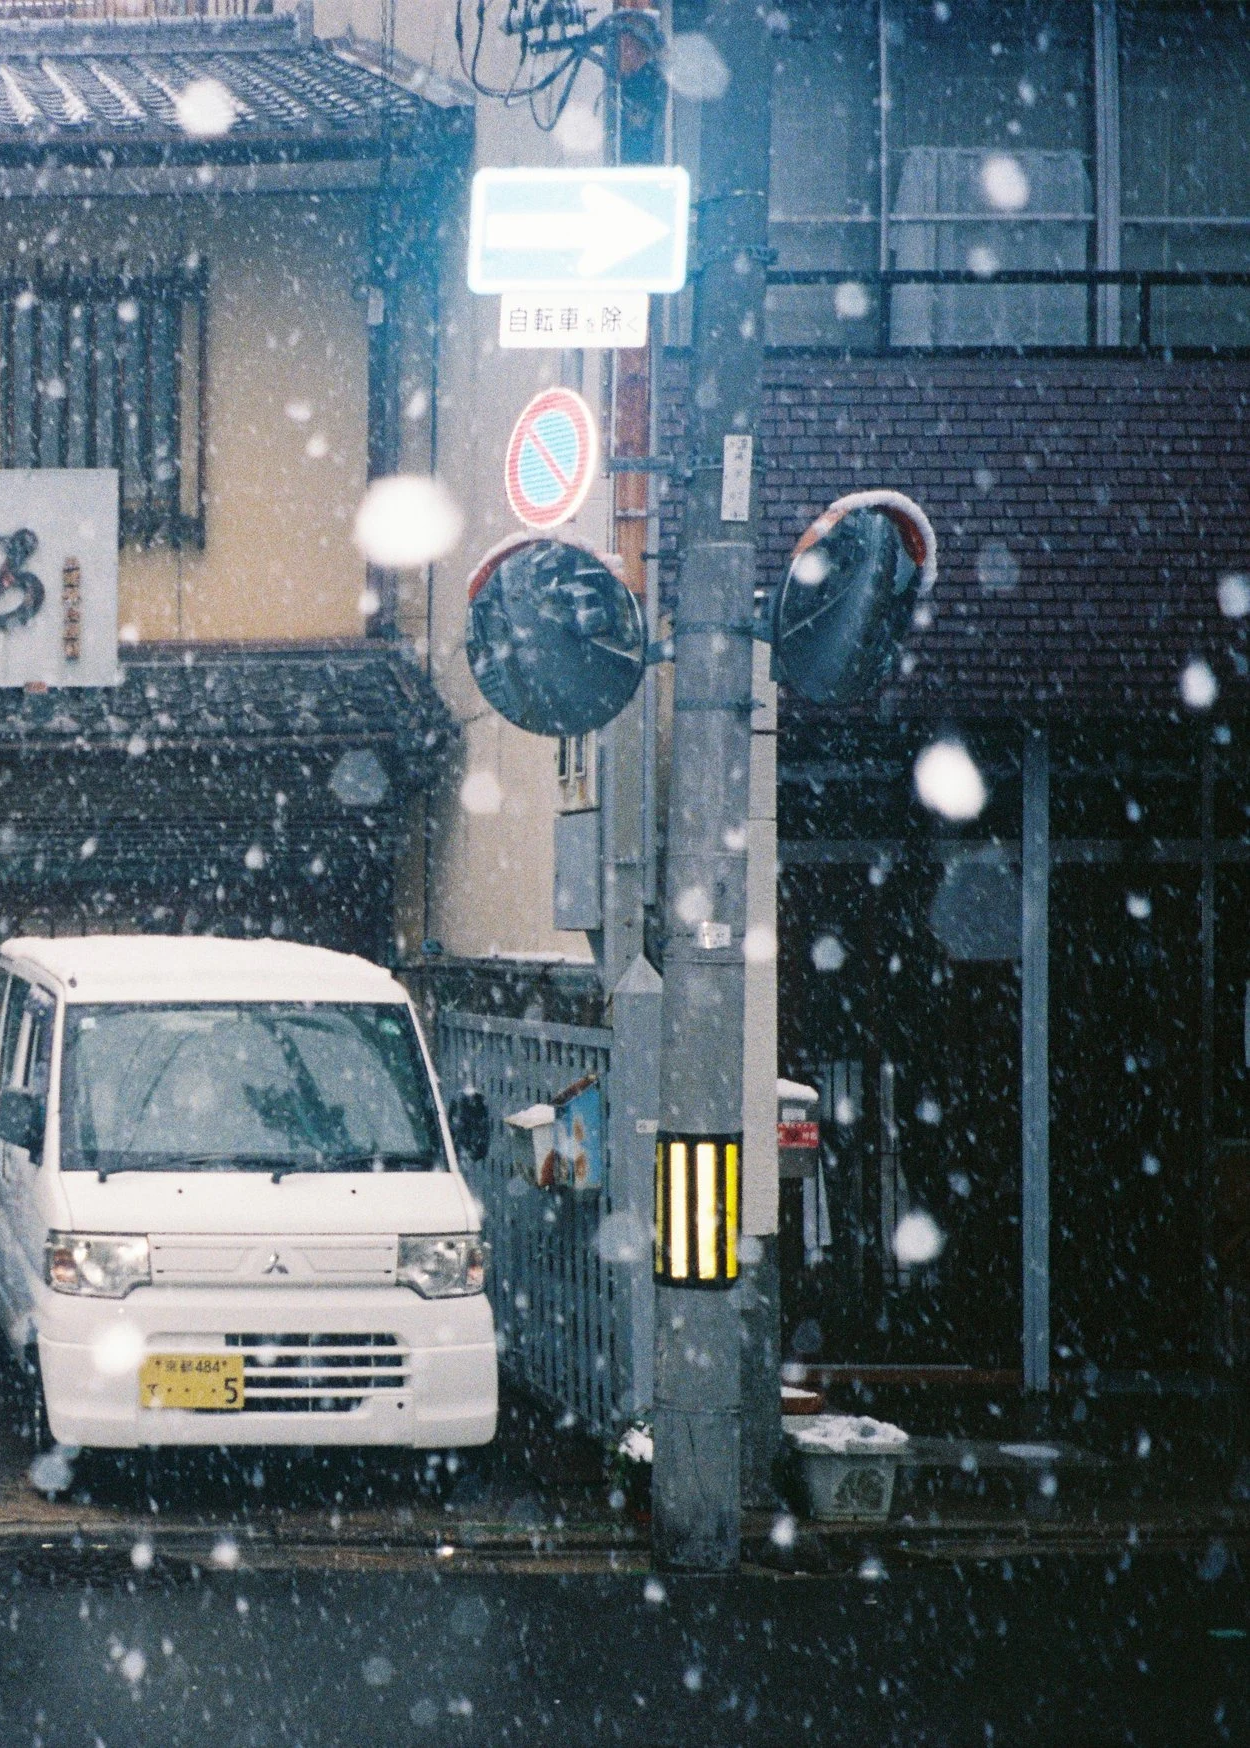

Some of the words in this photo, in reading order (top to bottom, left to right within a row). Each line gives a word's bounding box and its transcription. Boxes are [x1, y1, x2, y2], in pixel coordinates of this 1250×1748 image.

[509, 307, 638, 333] 自転車を除く
